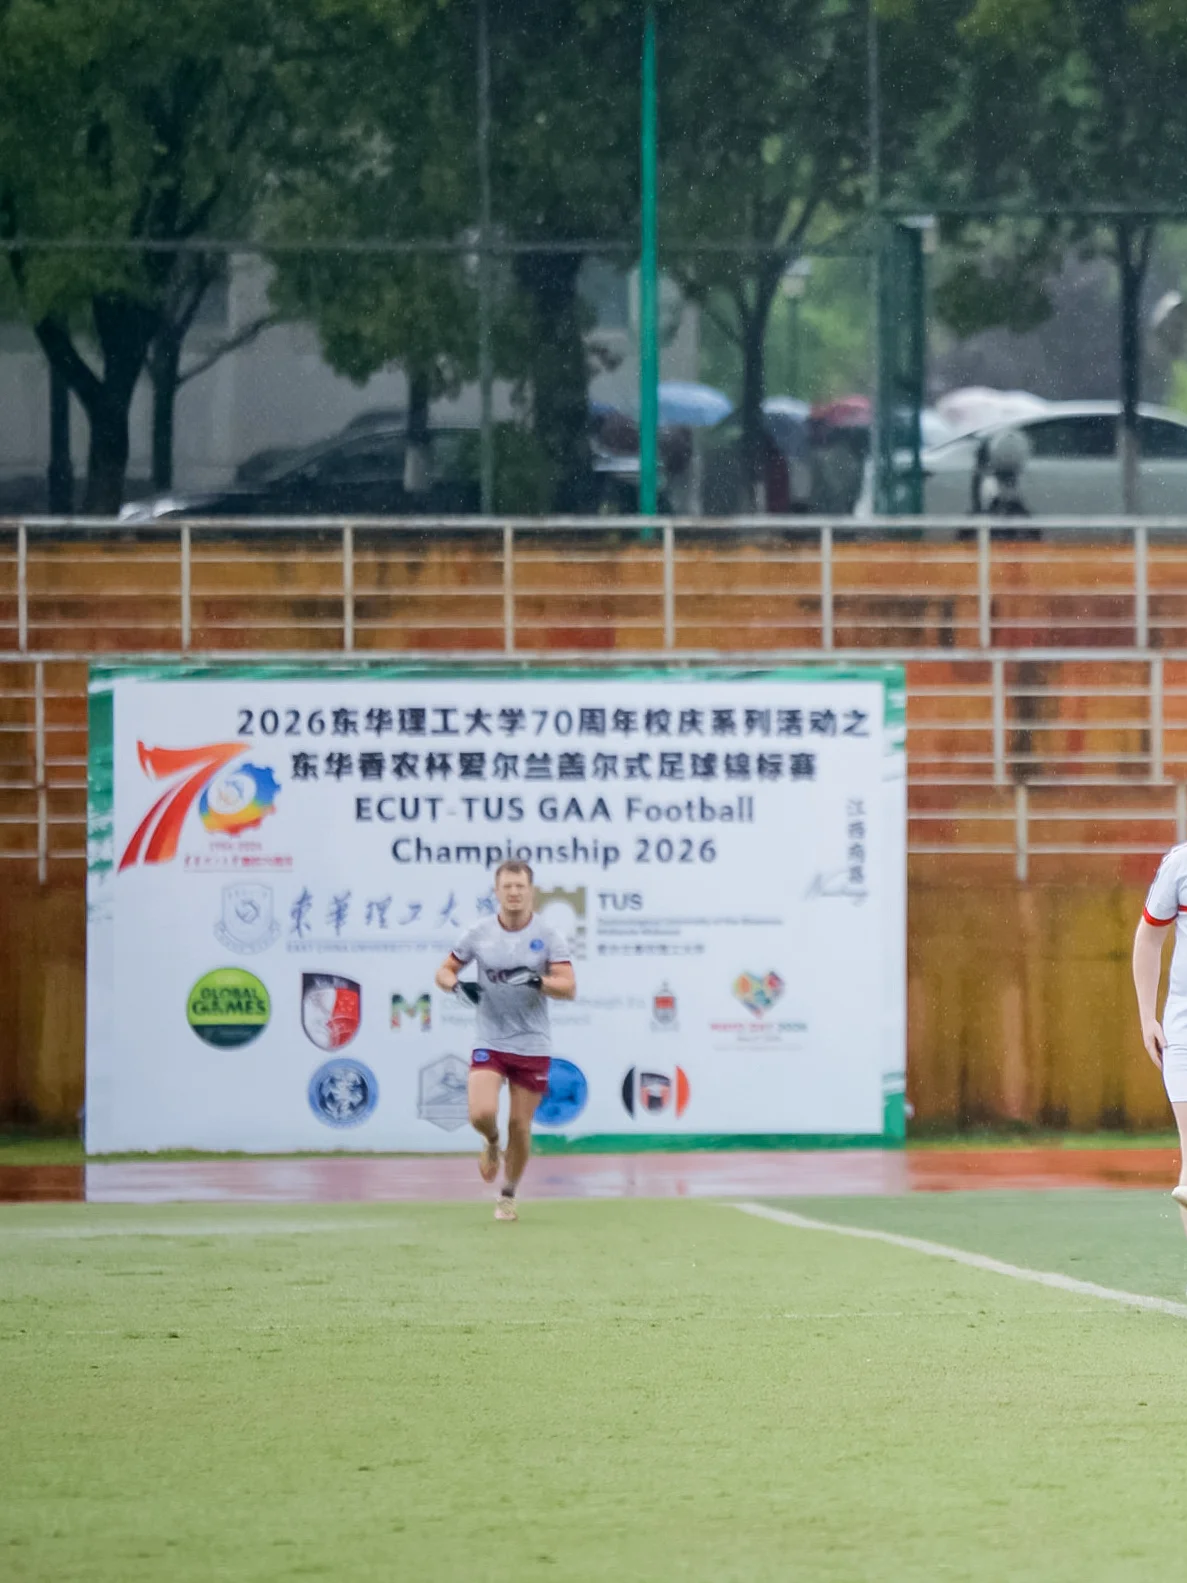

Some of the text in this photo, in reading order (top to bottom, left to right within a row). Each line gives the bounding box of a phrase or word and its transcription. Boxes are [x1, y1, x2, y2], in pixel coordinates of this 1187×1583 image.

[237, 707, 870, 736] 2026东华理工大学70周年校庆系列活动之
[290, 751, 816, 780] 东华香农杯爱尔兰盖尔式足球锦标赛
[538, 796, 612, 822] GAA
[626, 795, 755, 823] Football
[391, 836, 718, 869] Championship 2026
[597, 892, 643, 911] TUS
[192, 1000, 266, 1015] GAMES
[201, 987, 258, 1000] GLOBAL
